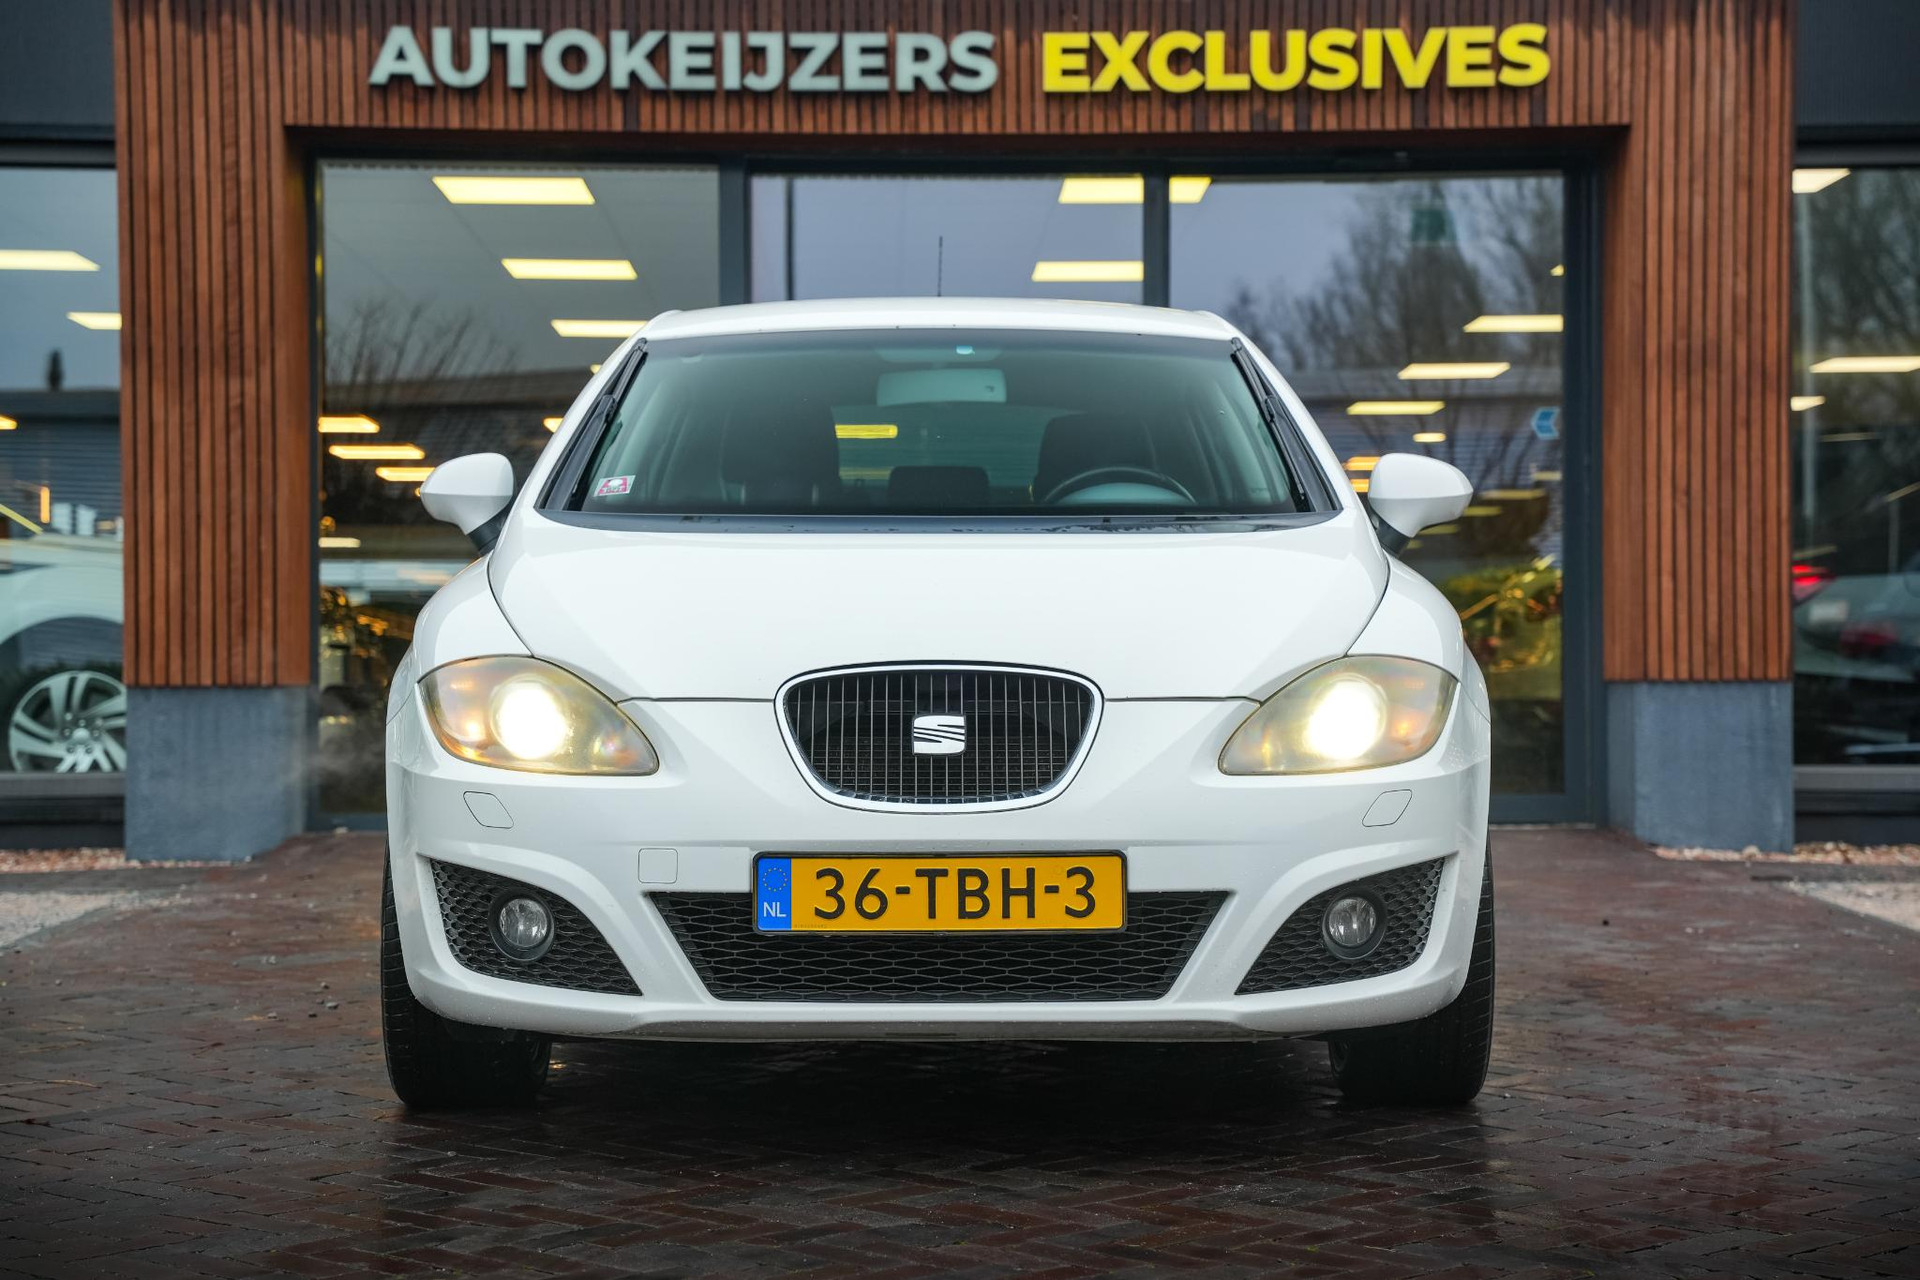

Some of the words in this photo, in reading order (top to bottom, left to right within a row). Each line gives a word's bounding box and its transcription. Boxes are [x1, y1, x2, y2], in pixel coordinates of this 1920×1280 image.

[368, 25, 997, 92] AUTOKEIJZERS
[1042, 23, 1551, 93] EXCLUSIVES
[763, 901, 787, 918] NL
[813, 866, 1096, 919] 36-TBH-3
